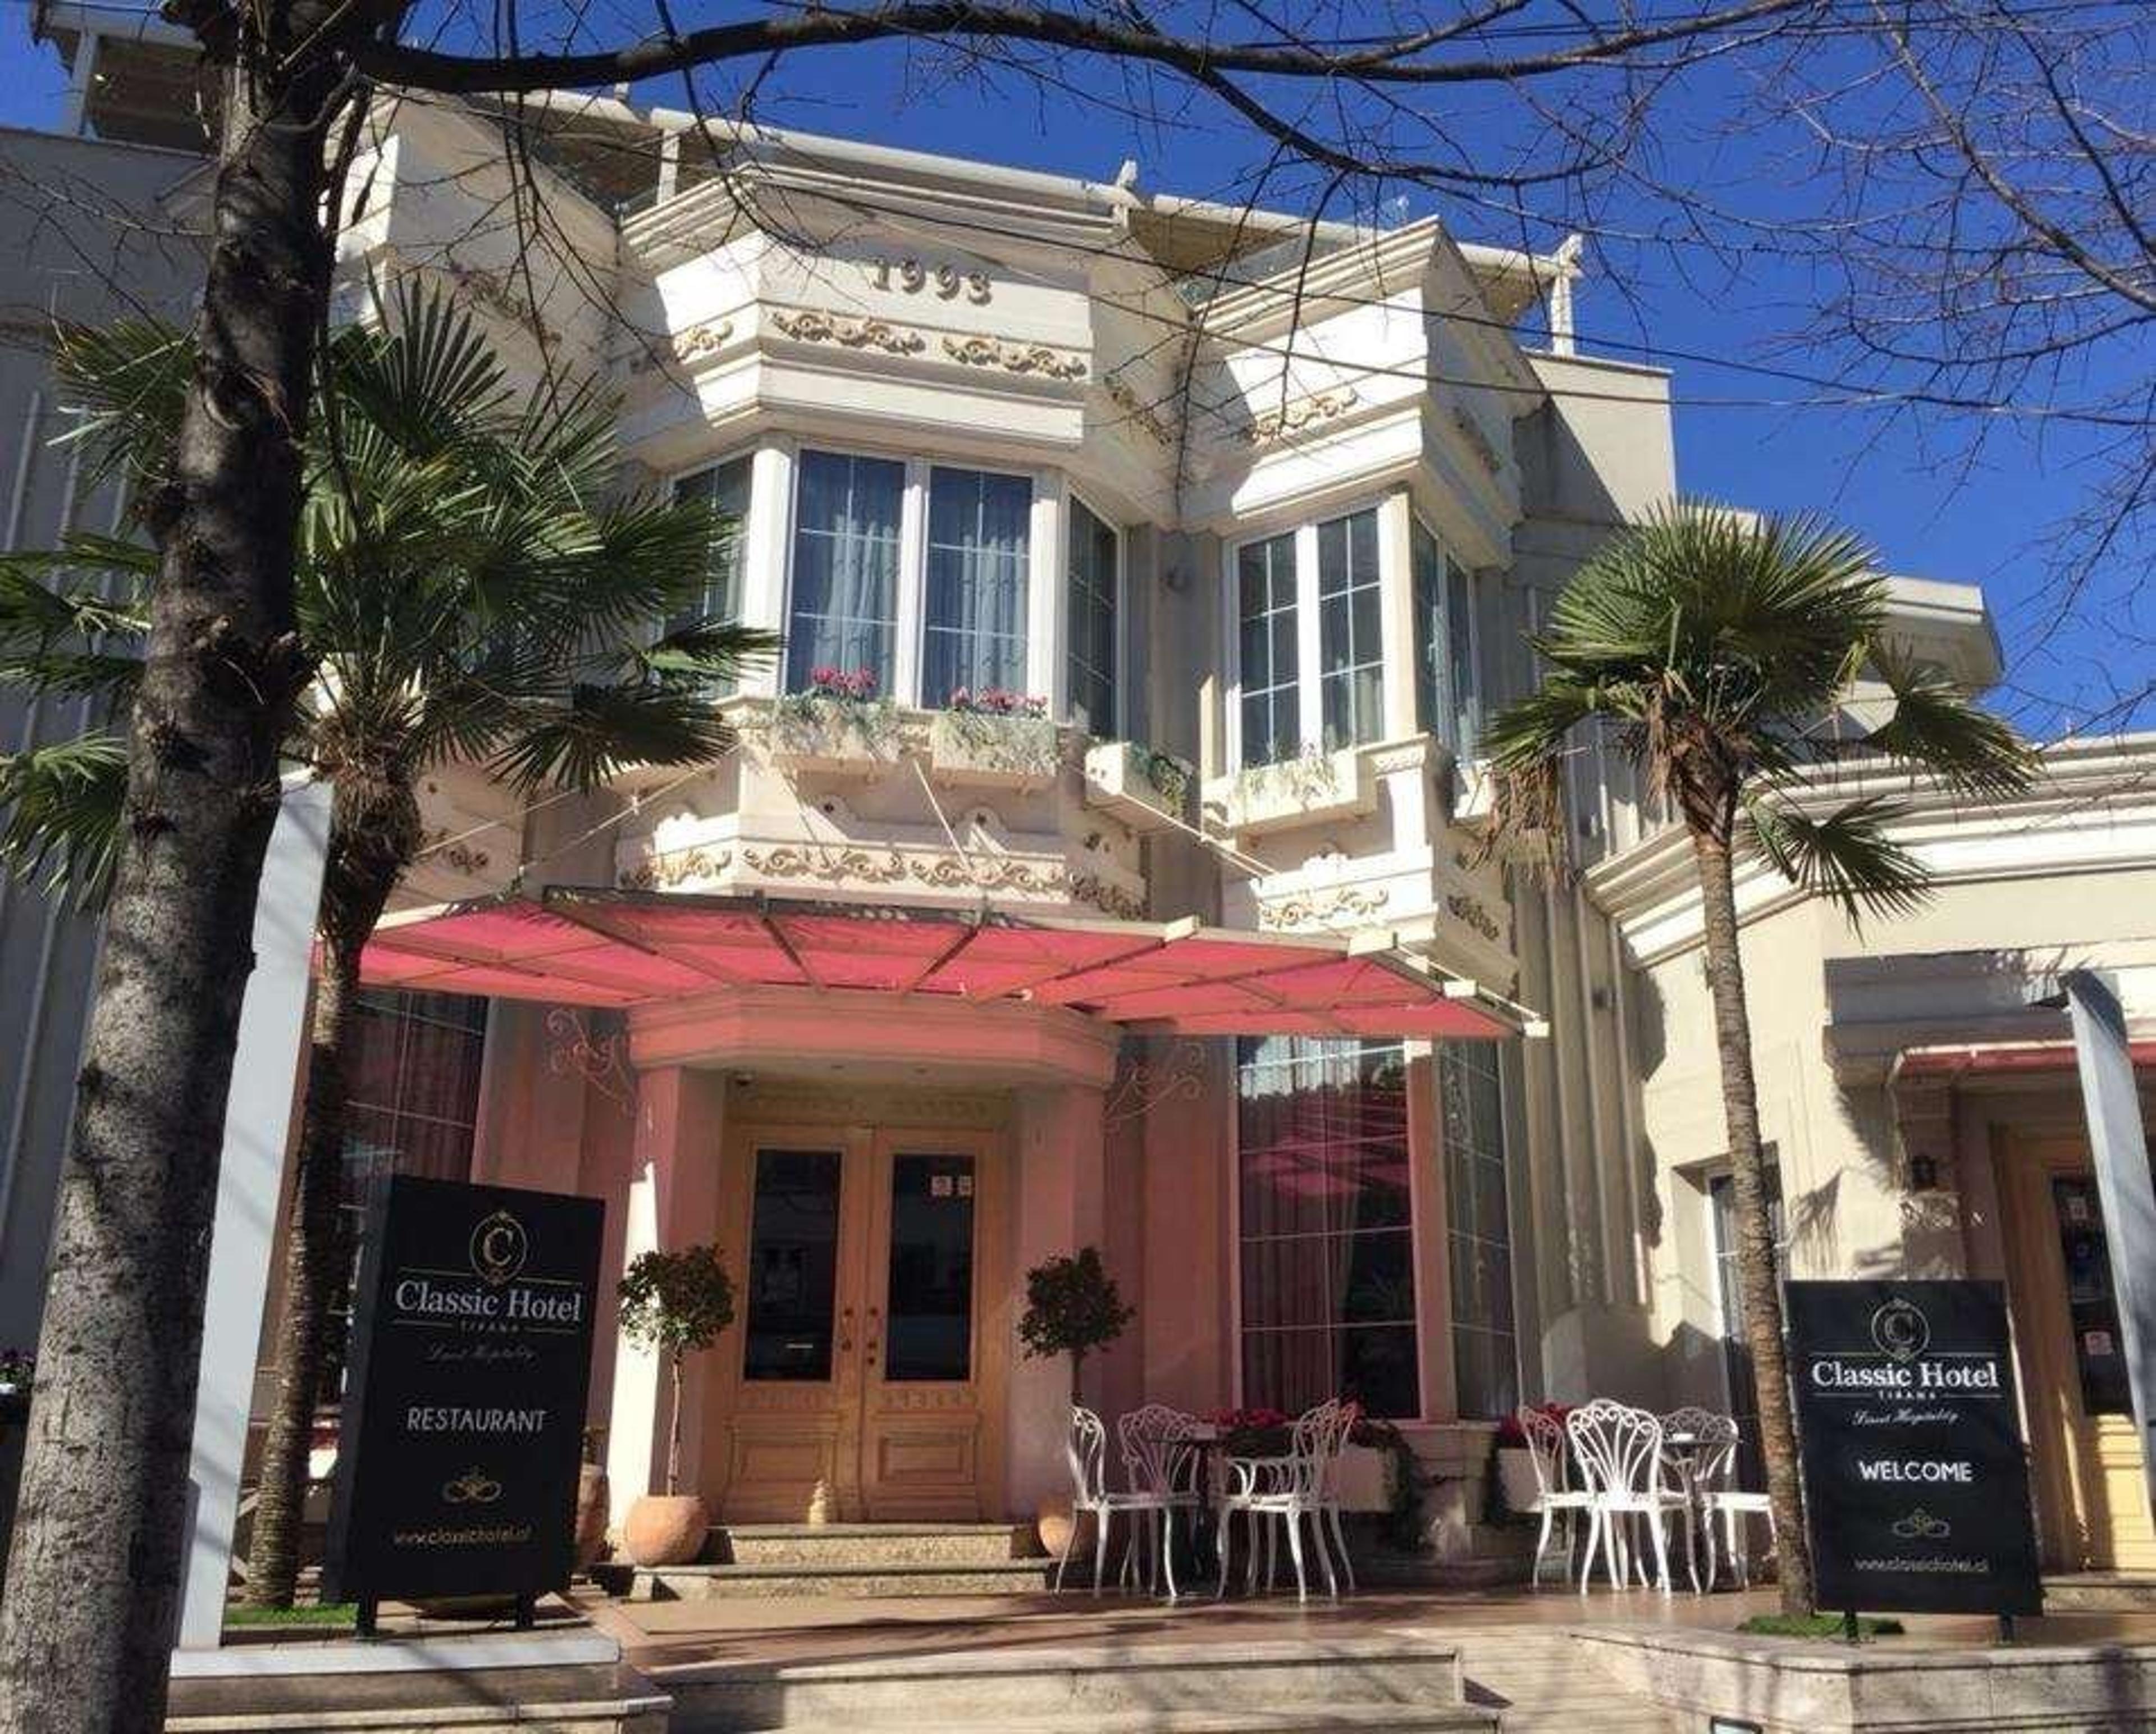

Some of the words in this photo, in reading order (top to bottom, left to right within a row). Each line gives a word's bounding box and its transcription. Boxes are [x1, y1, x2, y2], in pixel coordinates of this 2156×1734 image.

[873, 254, 992, 305] 1993
[482, 1228, 514, 1266] C
[395, 1280, 499, 1315] Classic
[506, 1289, 582, 1321] Hotel
[1811, 1361, 1913, 1387] Classic
[1919, 1361, 2000, 1388] Hotel
[407, 1407, 547, 1432] RESTAURANT
[1858, 1460, 1974, 1482] WELCOME
